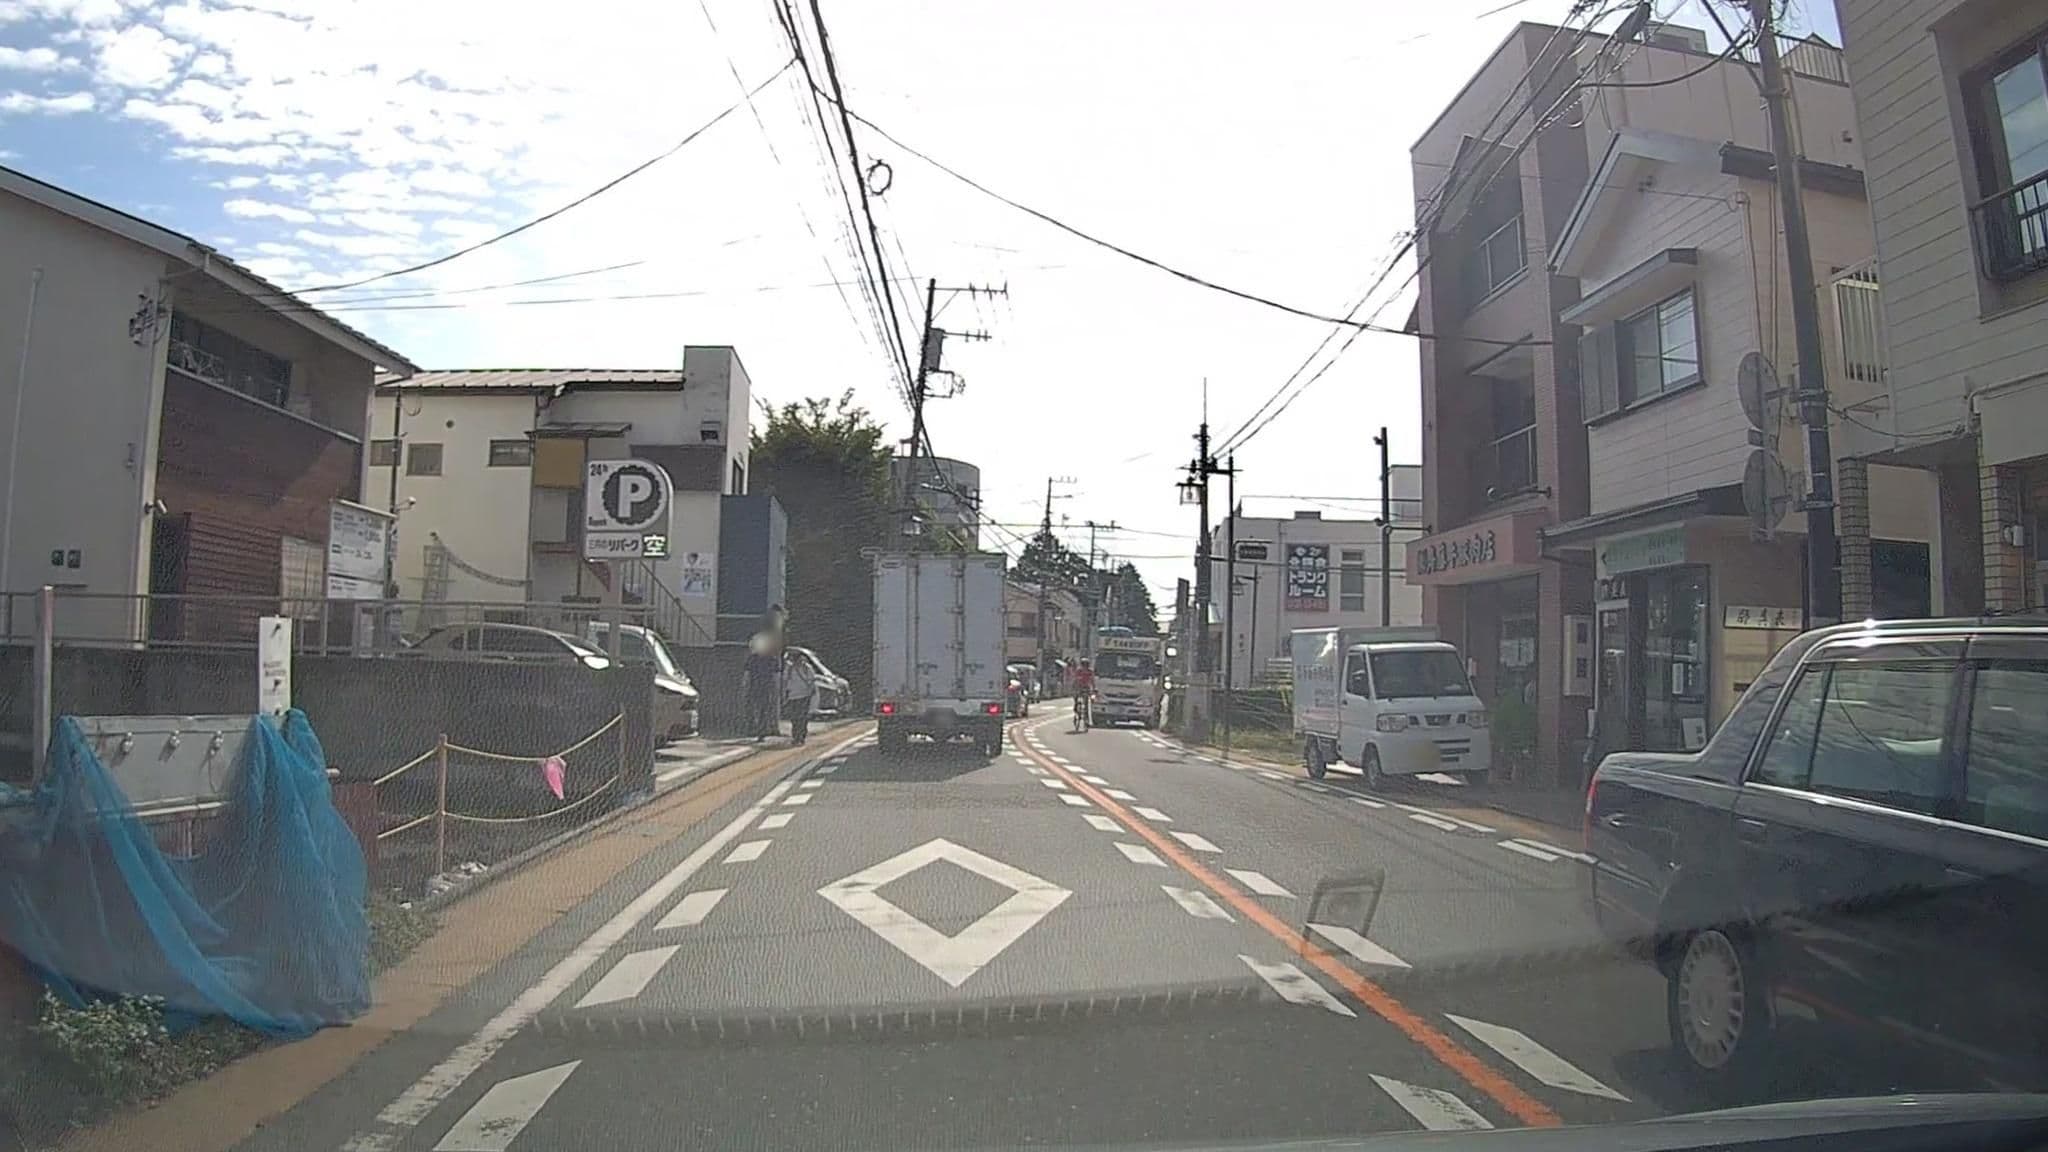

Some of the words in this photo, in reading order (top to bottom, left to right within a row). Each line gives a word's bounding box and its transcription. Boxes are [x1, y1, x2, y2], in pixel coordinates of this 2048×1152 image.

[618, 474, 653, 518] P
[643, 534, 667, 556] 空
[1289, 570, 1327, 584] トランク
[1288, 584, 1327, 597] ルーム
